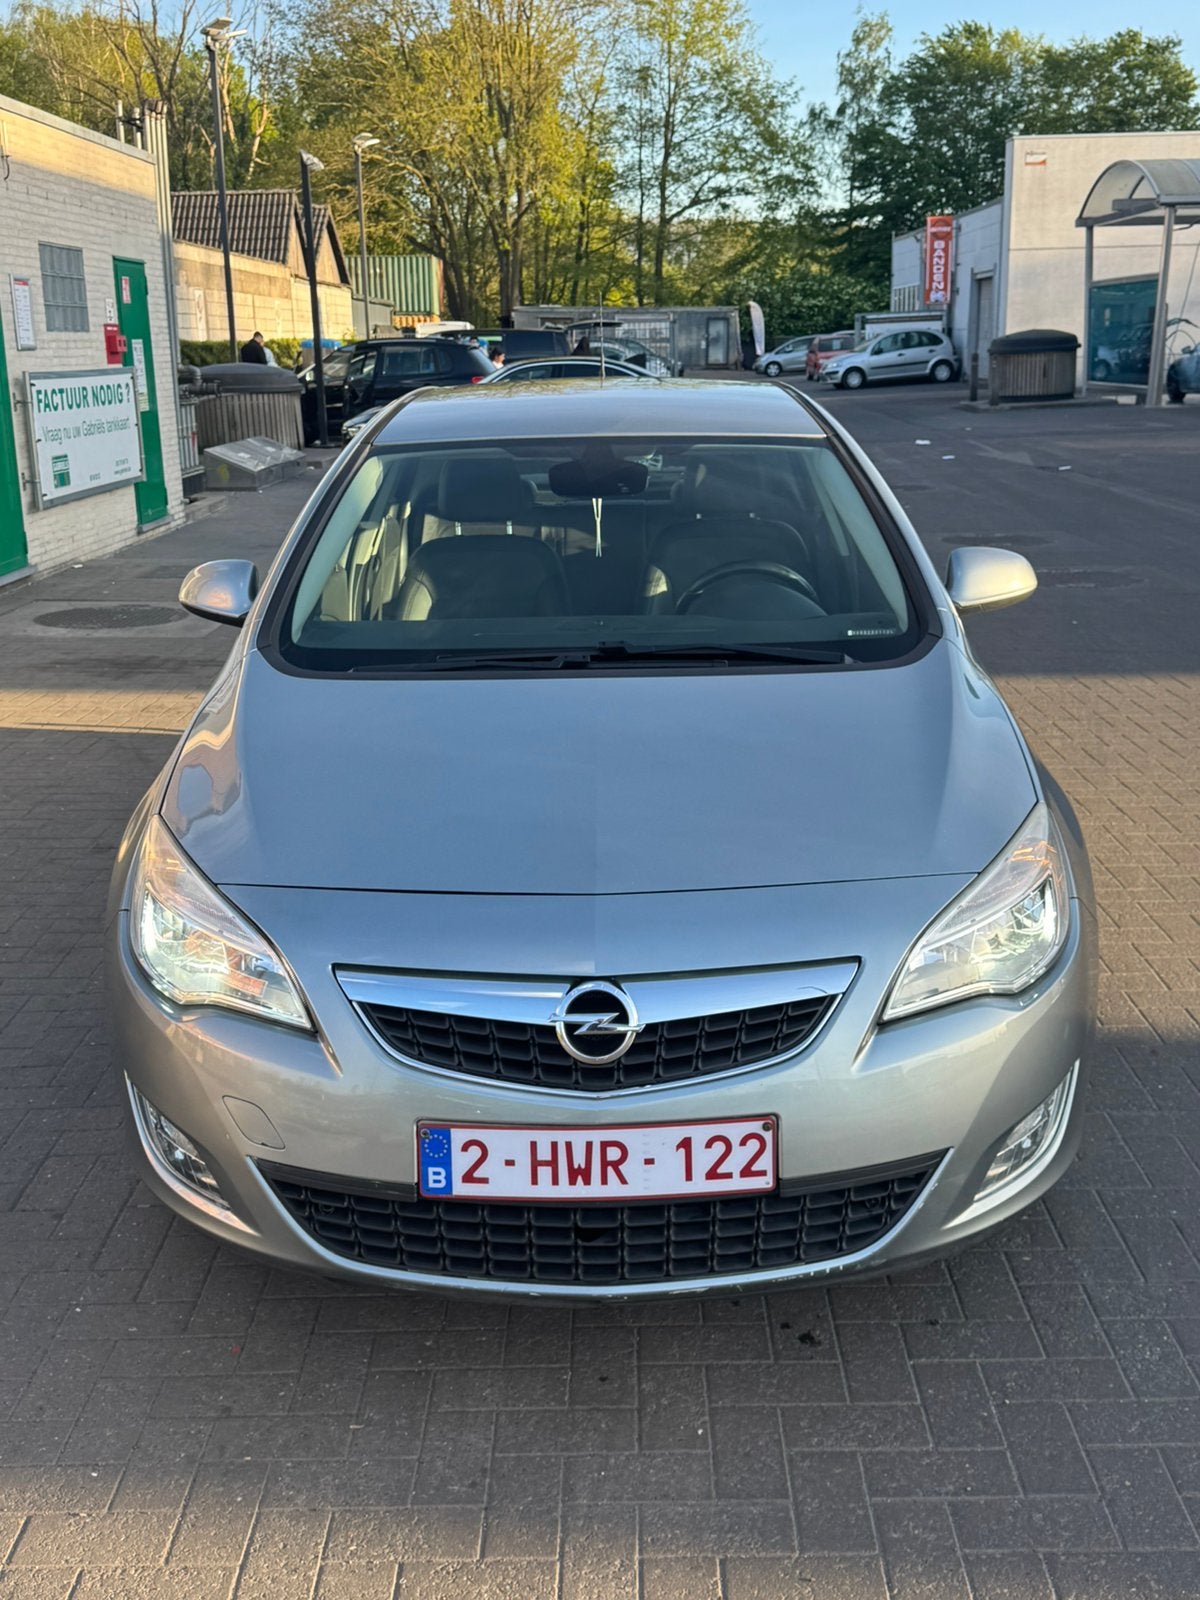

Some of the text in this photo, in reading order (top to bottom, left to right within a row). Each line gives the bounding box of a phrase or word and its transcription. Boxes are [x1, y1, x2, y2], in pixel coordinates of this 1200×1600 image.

[933, 240, 945, 291] BANDEN
[36, 383, 131, 413] FACTUUR NODIG ?
[42, 426, 63, 445] Vraag
[63, 426, 72, 440] nu
[72, 425, 81, 440] uw
[460, 1132, 768, 1186] 2-HWR-122
[427, 1167, 447, 1189] B
